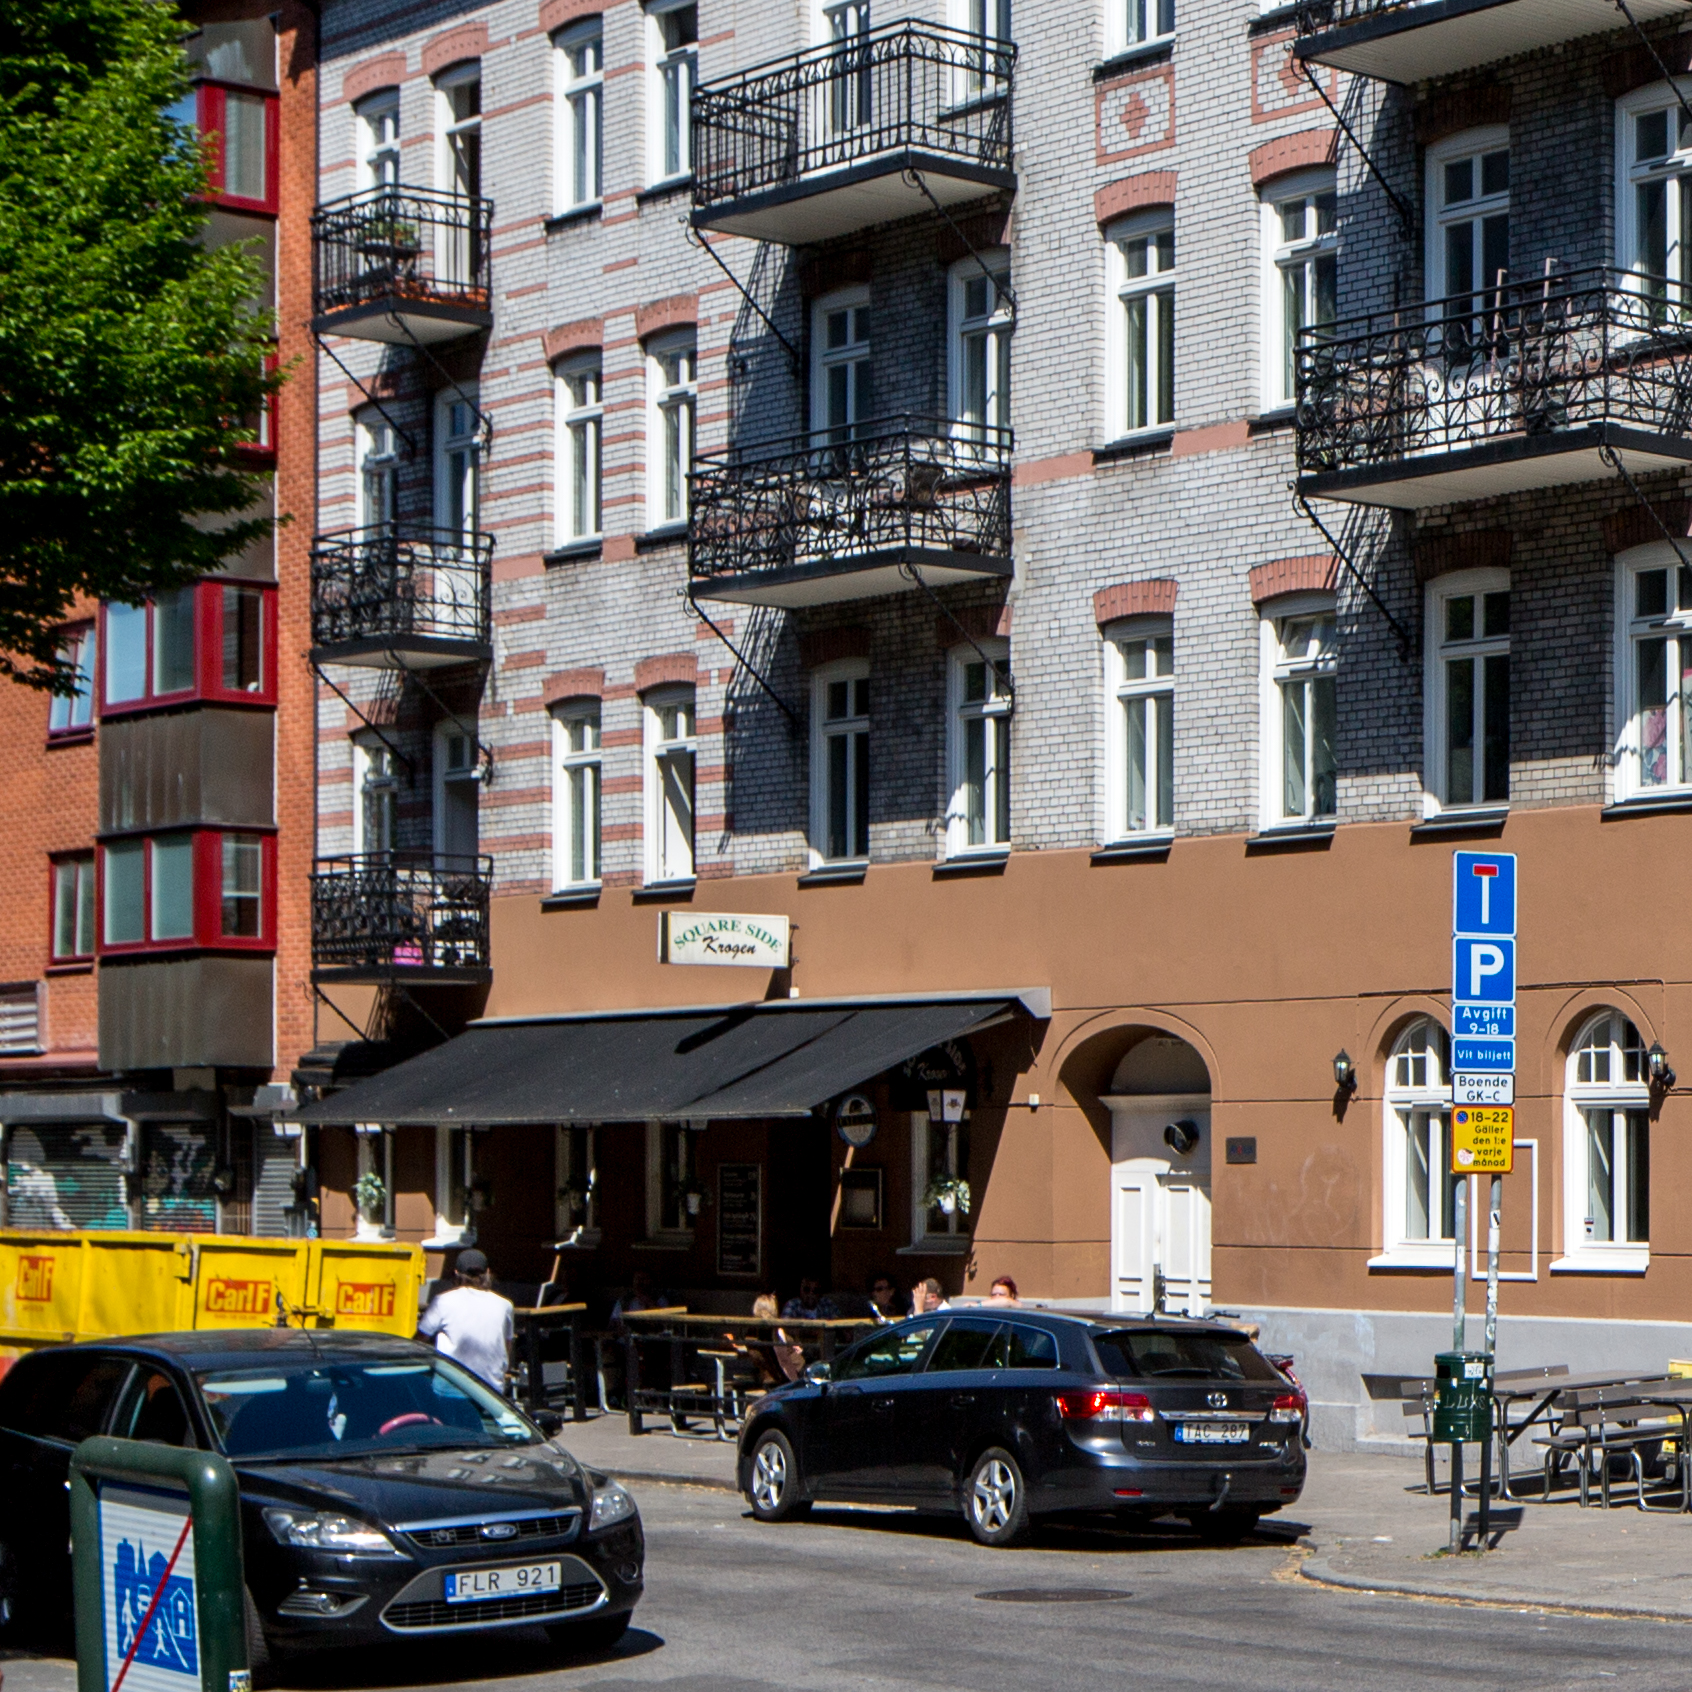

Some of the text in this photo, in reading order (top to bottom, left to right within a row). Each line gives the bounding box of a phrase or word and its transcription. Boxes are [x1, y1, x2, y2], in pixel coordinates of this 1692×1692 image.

[673, 919, 783, 953] SQUARE SIDE
[702, 935, 756, 960] Krogen
[1470, 943, 1505, 996] P
[1462, 1007, 1507, 1021] Avgift
[1469, 1022, 1499, 1035] 9-18
[1457, 1050, 1511, 1062] Vit biljett
[1459, 1076, 1508, 1087] Boende
[1466, 1090, 1500, 1102] GK-C
[1471, 1111, 1509, 1123] 18-22
[1474, 1125, 1504, 1134] Gäller
[1472, 1136, 1491, 1145] den
[1476, 1147, 1502, 1157] varje
[1472, 1158, 1505, 1166] månad
[1185, 1423, 1246, 1438] TAC 287
[459, 1565, 555, 1594] FLR 921
